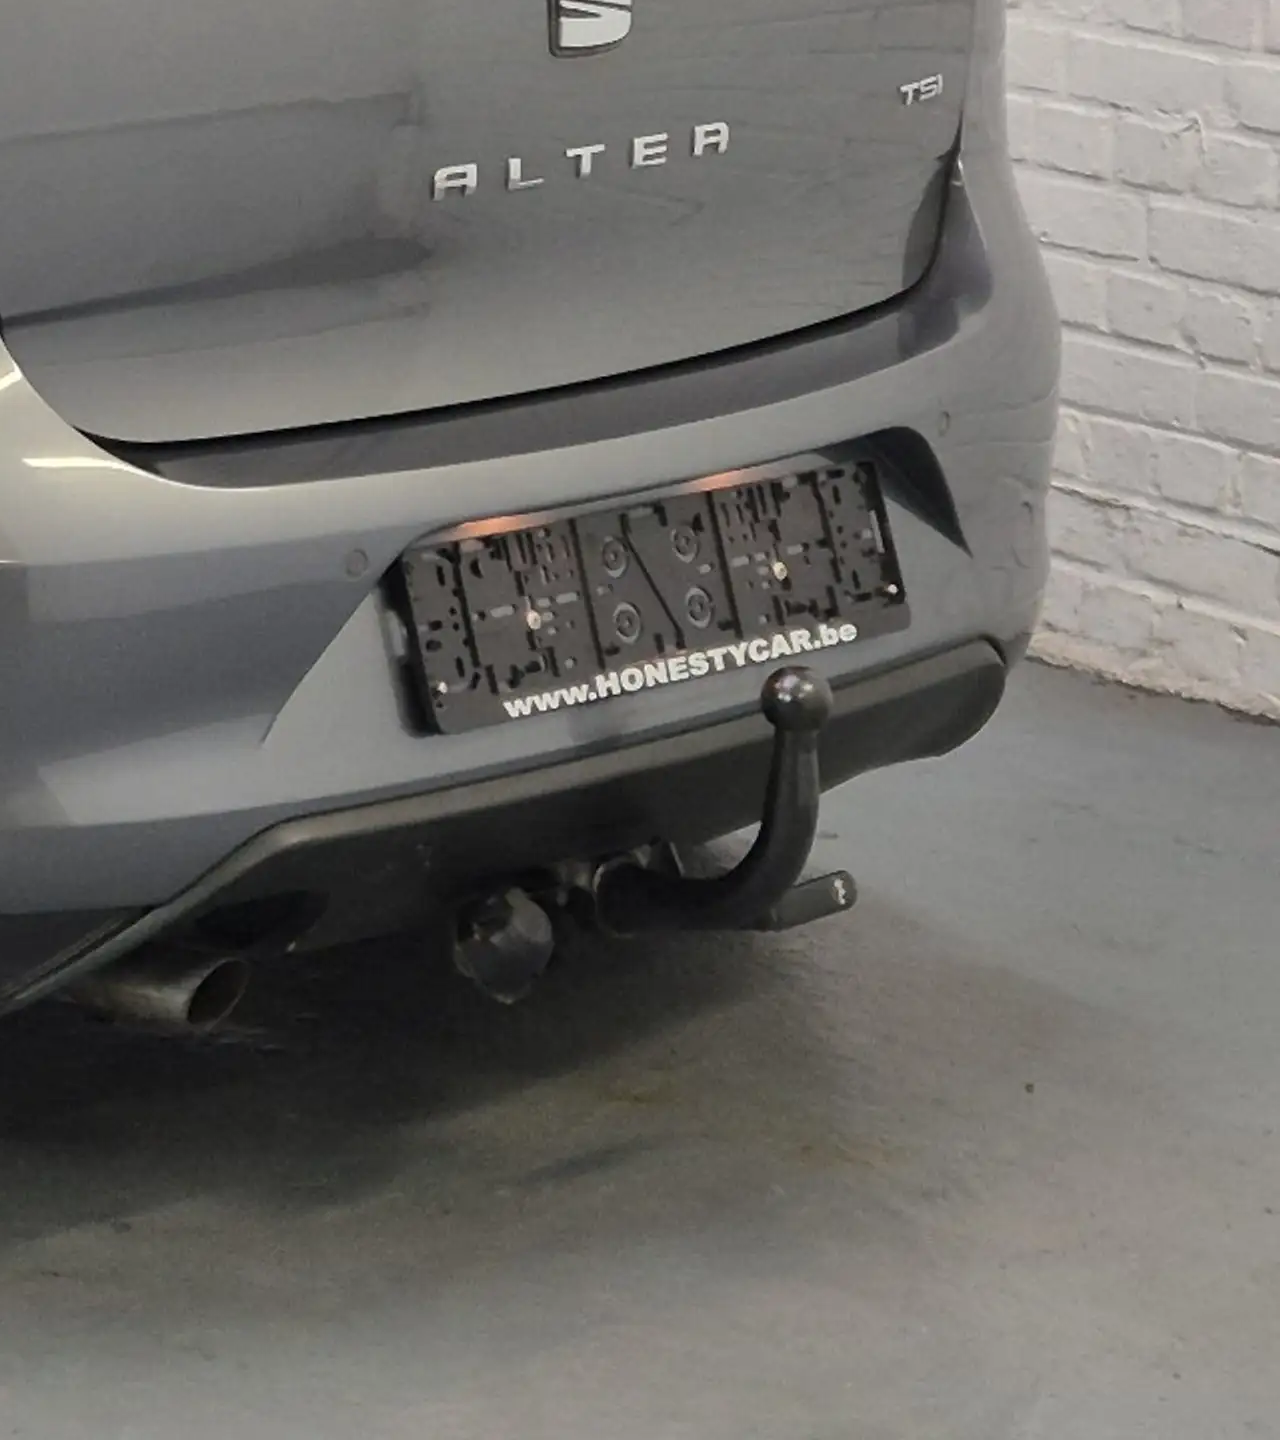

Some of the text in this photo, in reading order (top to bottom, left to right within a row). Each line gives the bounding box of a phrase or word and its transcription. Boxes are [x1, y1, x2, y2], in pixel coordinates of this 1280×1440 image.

[899, 74, 943, 106] TSI
[432, 121, 730, 201] ALTEA
[503, 622, 858, 719] www.HONESTYCAR.be
